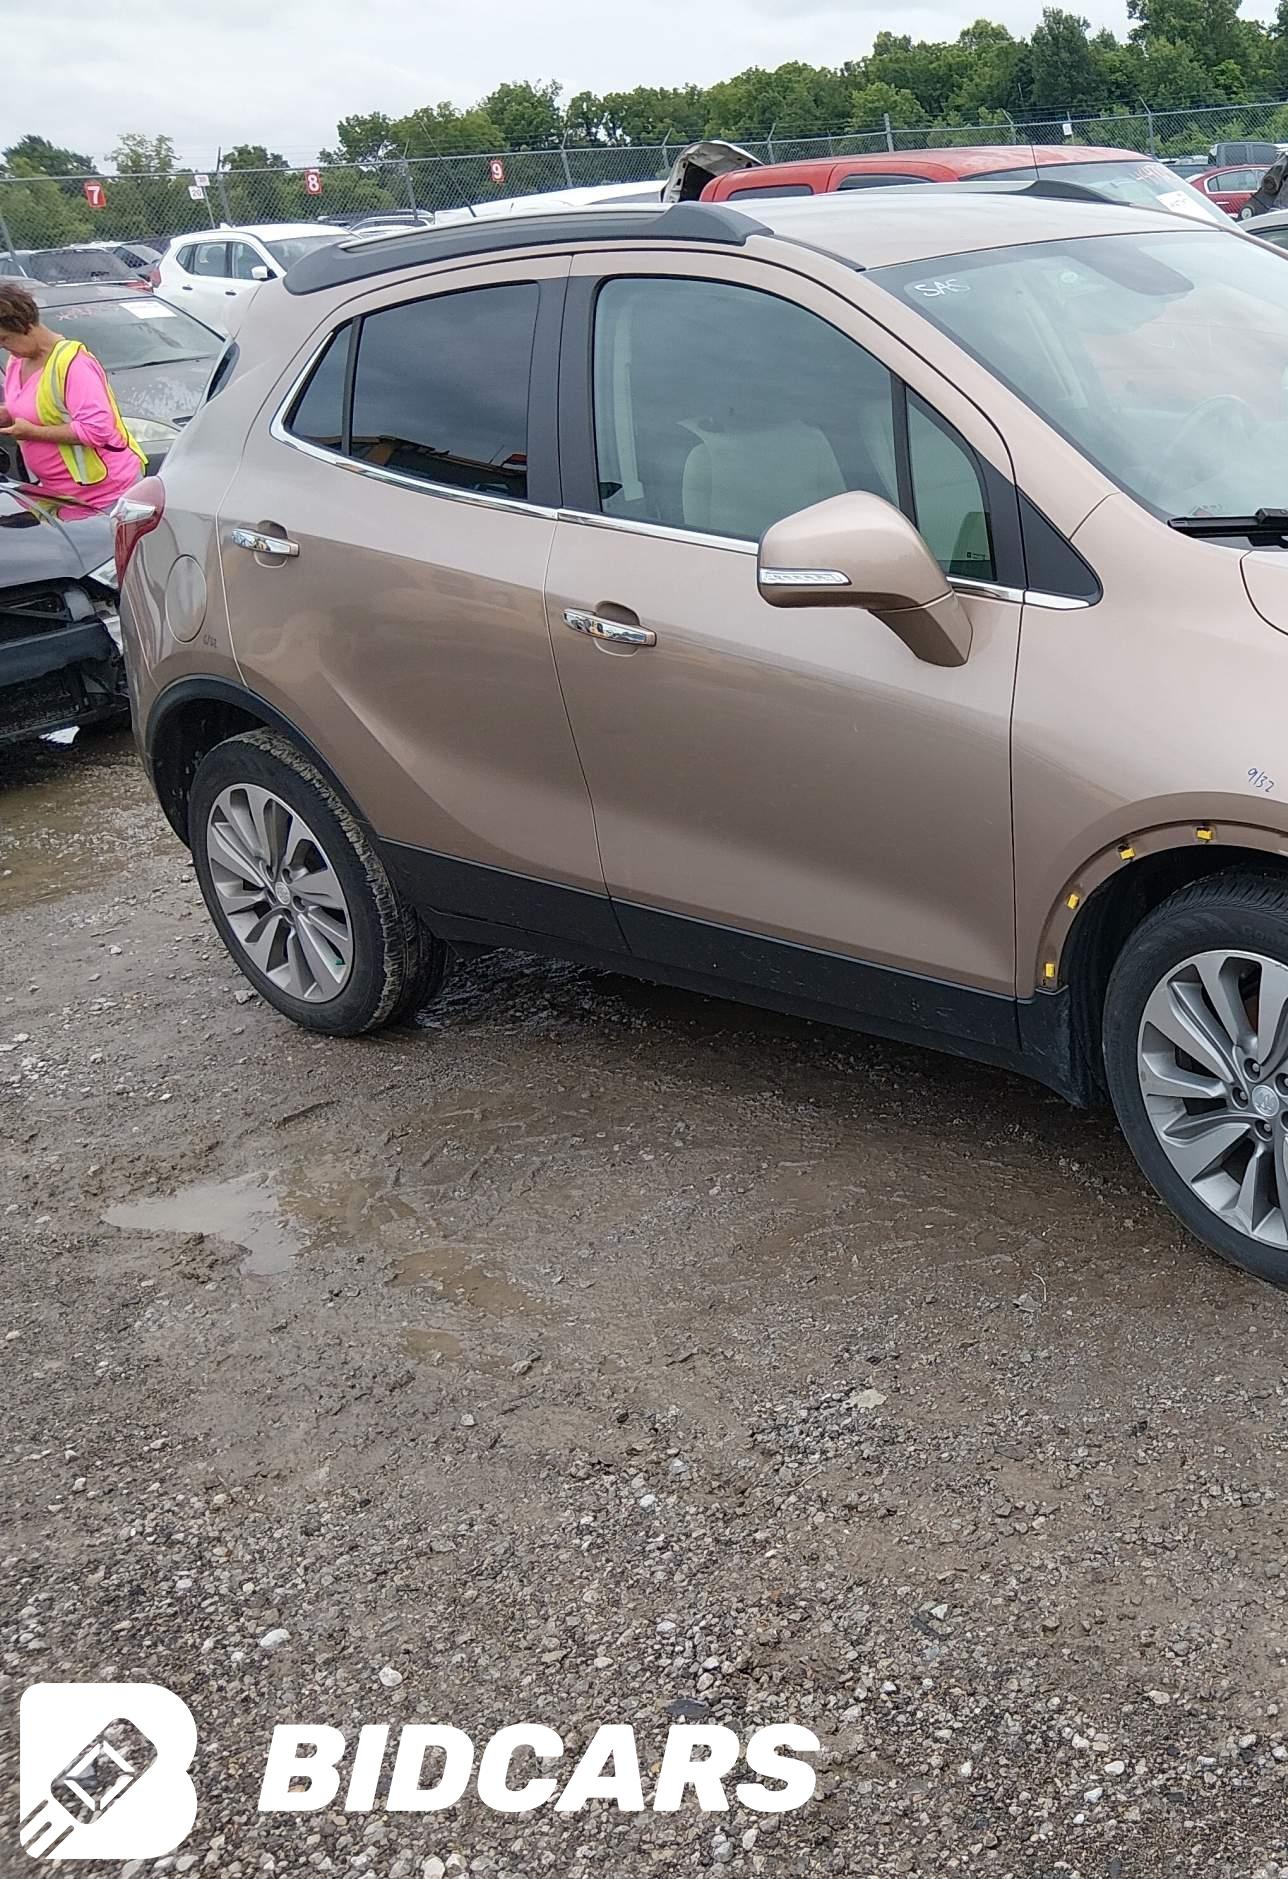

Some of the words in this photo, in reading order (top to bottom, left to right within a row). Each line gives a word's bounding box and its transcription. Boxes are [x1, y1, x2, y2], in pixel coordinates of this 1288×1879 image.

[492, 163, 502, 179] 9
[308, 174, 320, 191] 8
[87, 185, 100, 205] 7
